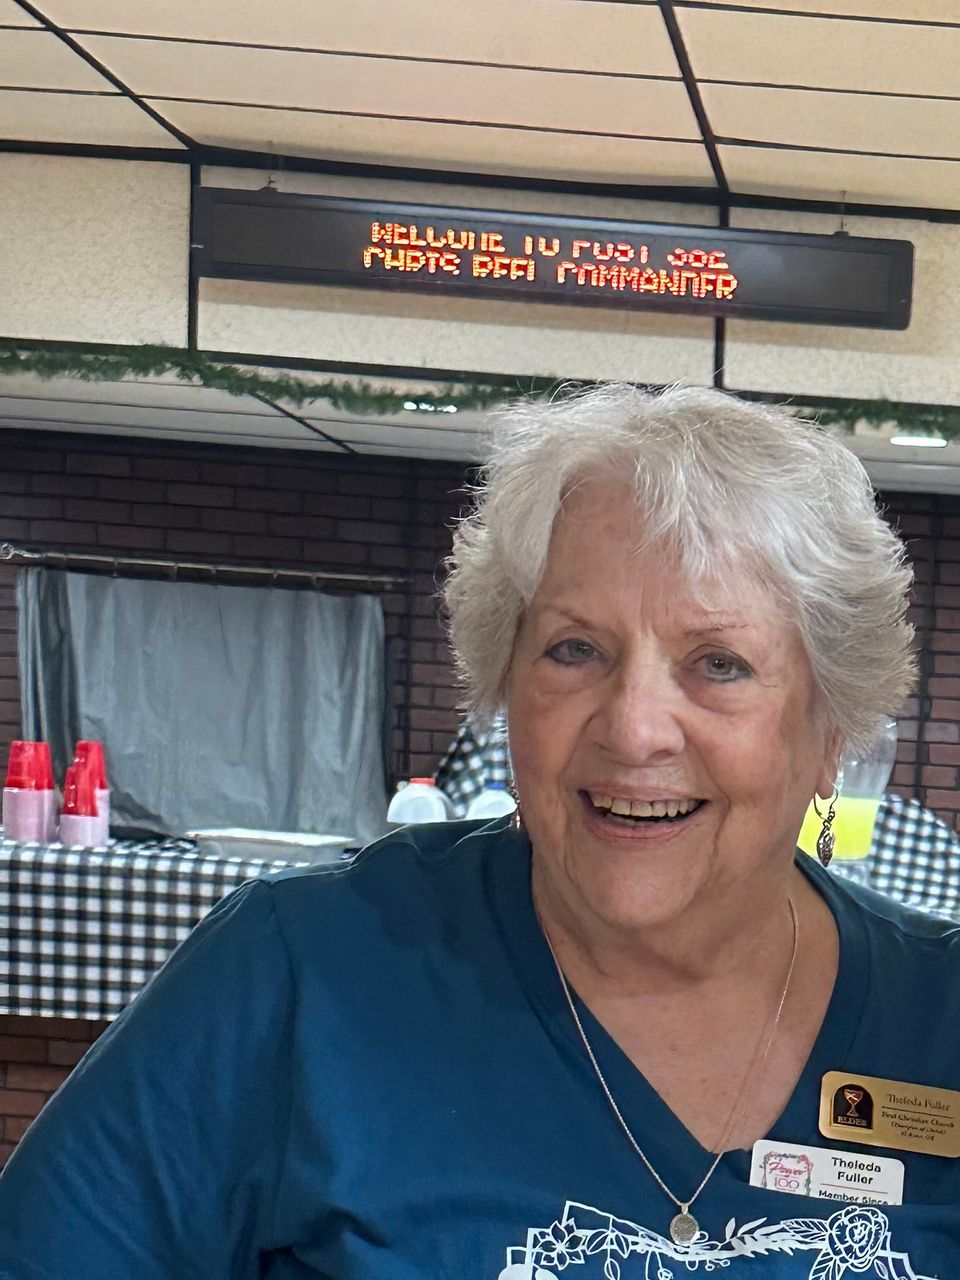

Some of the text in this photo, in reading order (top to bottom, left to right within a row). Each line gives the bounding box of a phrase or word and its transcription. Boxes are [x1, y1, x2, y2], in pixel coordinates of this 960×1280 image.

[831, 1156, 882, 1174] Theleda
[837, 1170, 874, 1185] Fuller
[818, 1189, 860, 1203] Member
